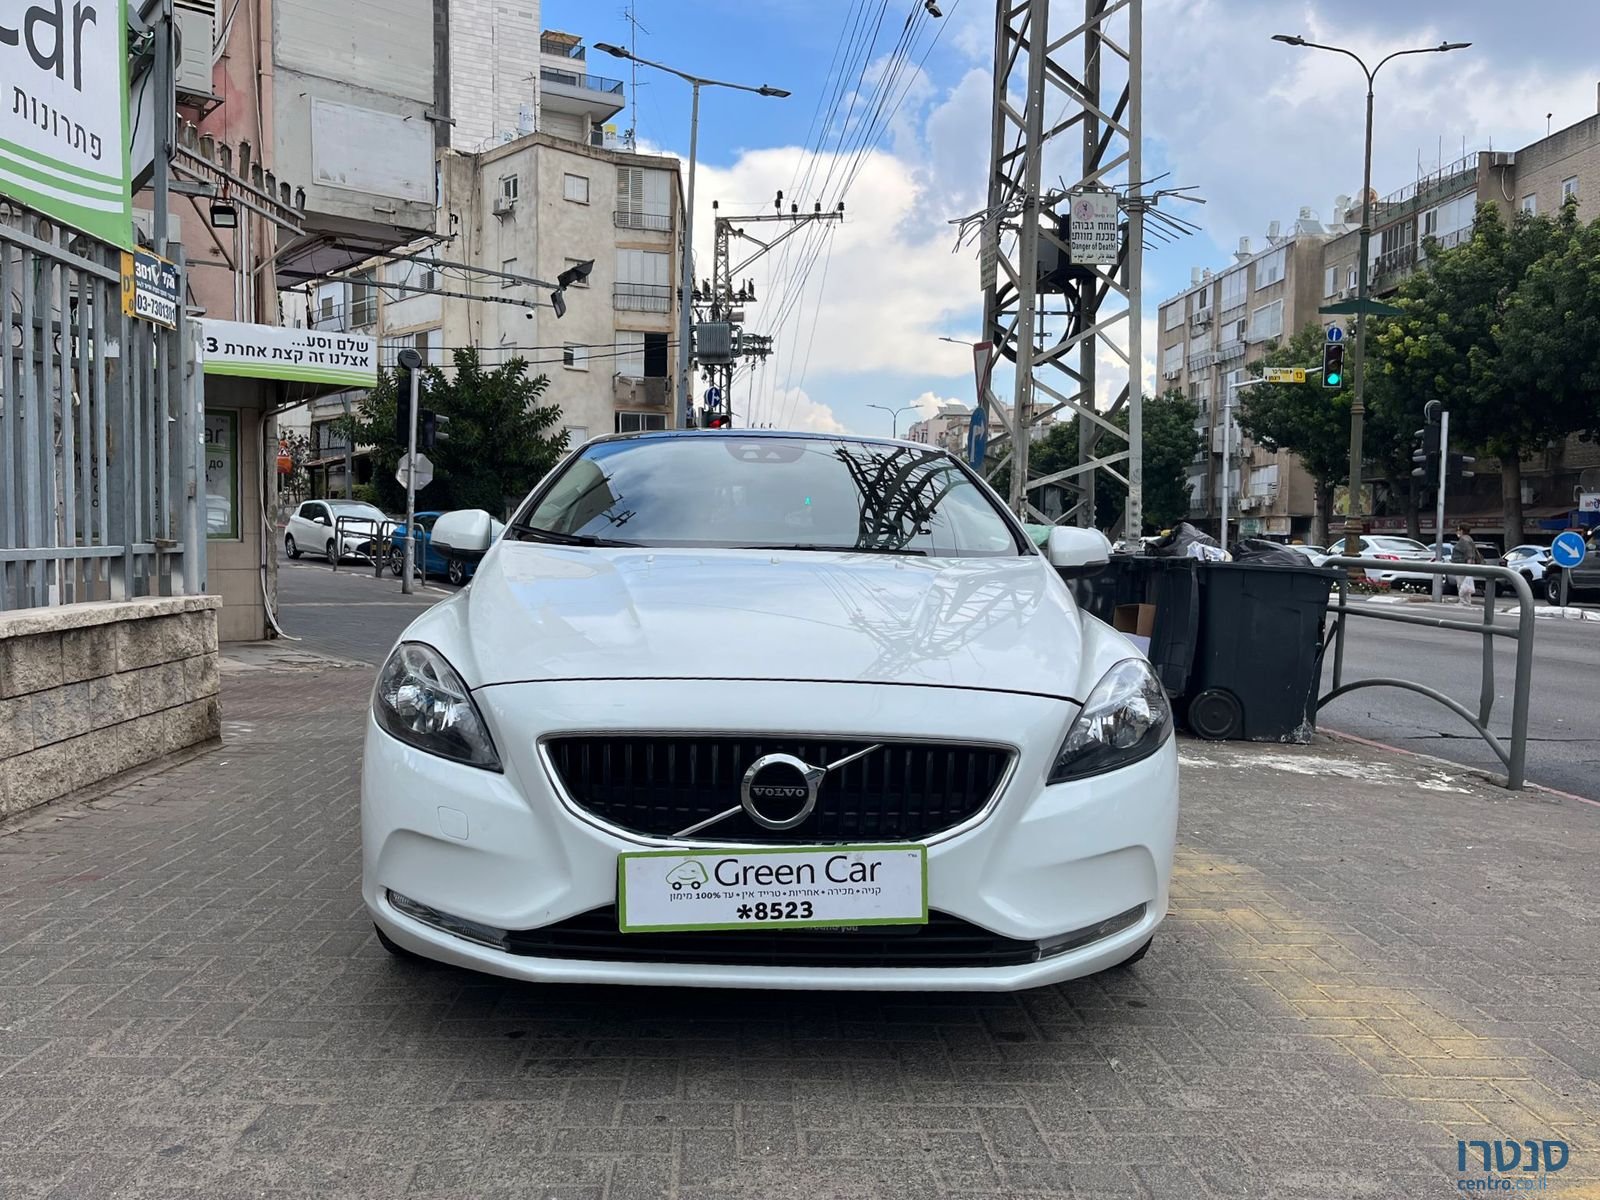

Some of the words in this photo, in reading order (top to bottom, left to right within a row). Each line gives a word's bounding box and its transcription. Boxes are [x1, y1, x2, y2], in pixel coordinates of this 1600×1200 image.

[0, 0, 96, 92] ar
[13, 86, 102, 160] פתרונות
[1098, 222, 1115, 230] מתח
[1096, 232, 1115, 241] סכנת
[1072, 242, 1091, 251] Danger
[1092, 242, 1098, 250] of
[1098, 242, 1116, 250] Death!
[135, 261, 152, 282] 301
[203, 337, 219, 353] 3
[224, 343, 267, 358] אחרת
[336, 338, 369, 352] שלם
[272, 348, 303, 364] קצת
[309, 351, 325, 363] זה
[329, 352, 369, 367] אצלנו
[208, 459, 224, 470] до
[752, 787, 805, 797] VOLVO
[714, 859, 816, 887] Green
[824, 855, 881, 883] Car
[669, 892, 693, 901] מימון
[695, 891, 721, 900] 100%
[742, 891, 755, 899] אין
[788, 889, 820, 897] אחריות
[861, 887, 881, 896] קניה
